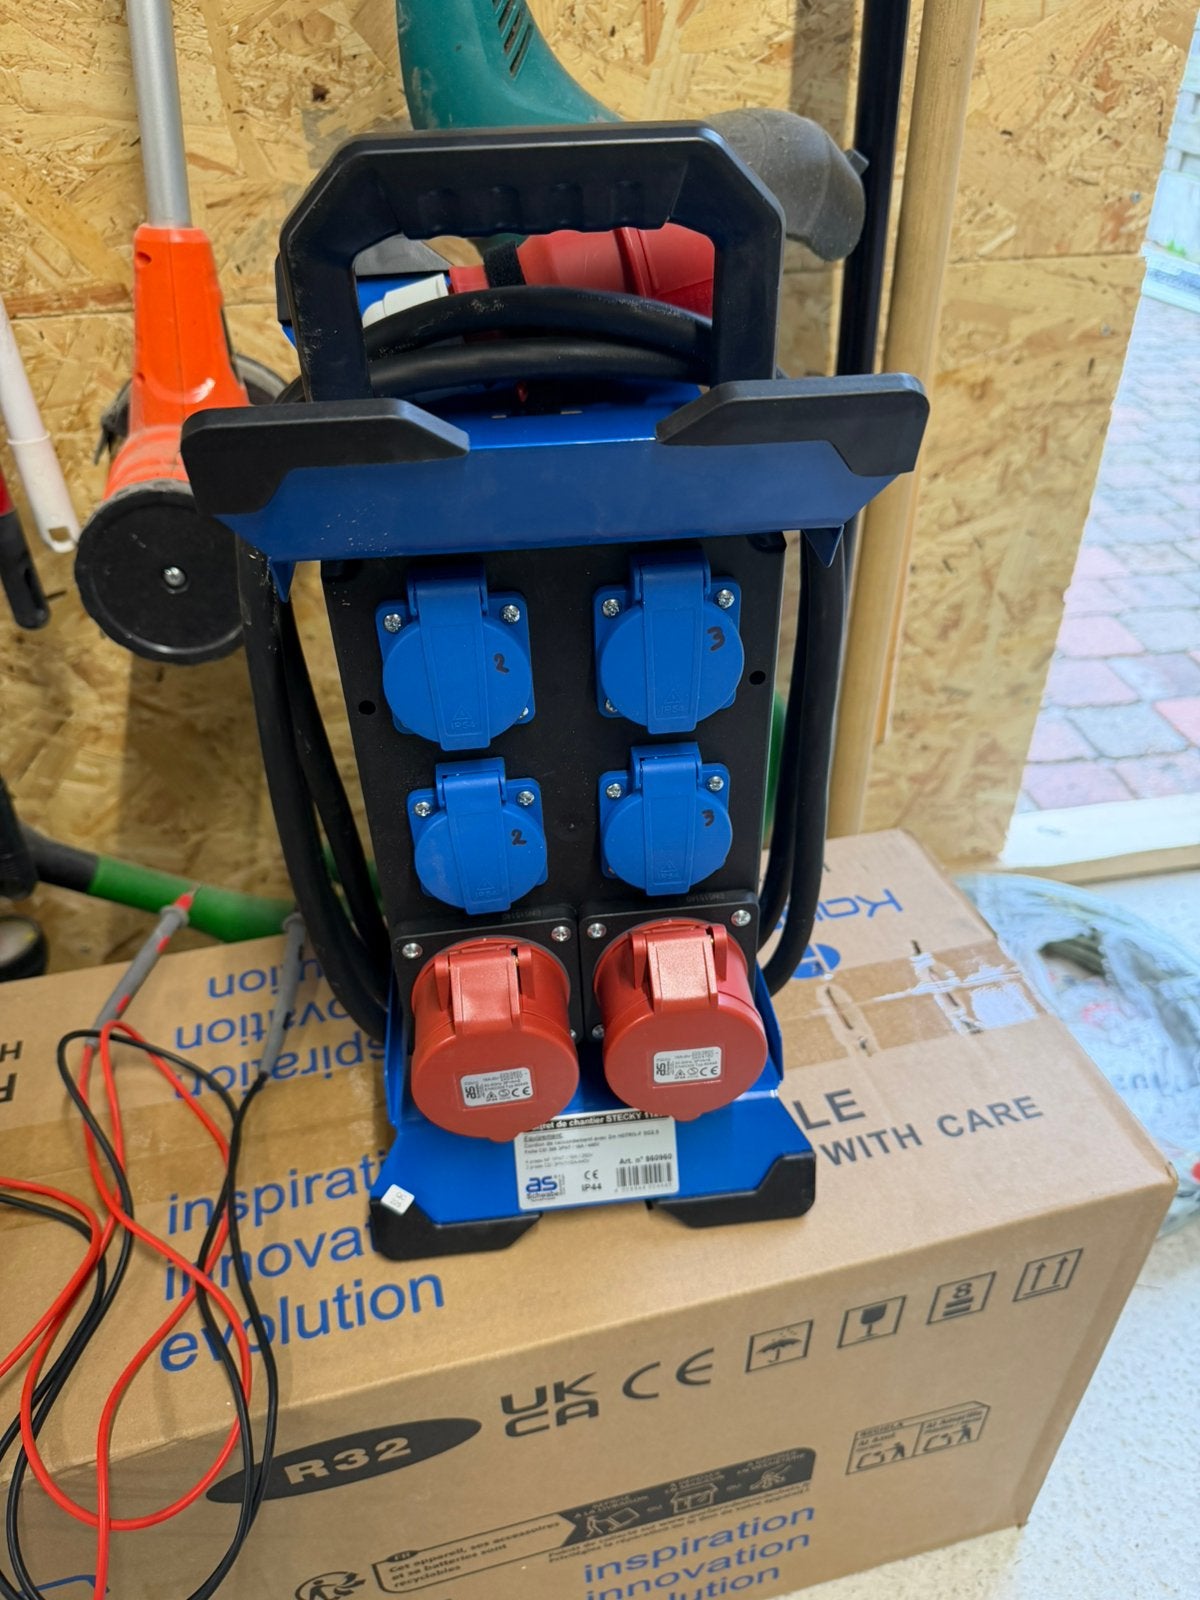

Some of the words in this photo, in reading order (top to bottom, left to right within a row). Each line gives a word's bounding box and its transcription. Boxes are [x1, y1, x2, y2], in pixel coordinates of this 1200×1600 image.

[707, 626, 725, 652] 3
[493, 653, 509, 674] 2
[511, 829, 527, 845] 2
[699, 1065, 719, 1077] CE
[511, 1085, 531, 1098] CE
[792, 1088, 866, 1130] LE
[555, 1119, 568, 1127] de
[568, 1116, 604, 1126] chantier
[605, 1111, 642, 1123] STECKY
[819, 1123, 924, 1166] WITH
[937, 1096, 1044, 1138] CARE
[619, 1157, 633, 1165] Art.
[526, 1174, 558, 1193] as
[583, 1169, 599, 1181] CE
[581, 1182, 602, 1192] IP44
[952, 1281, 972, 1299] 8
[622, 1347, 715, 1400] CE
[501, 1371, 598, 1415] UK
[505, 1399, 599, 1438] CA
[284, 1437, 412, 1485] R32
[584, 1506, 815, 1584] inspiration
[389, 1562, 411, 1573] Cet
